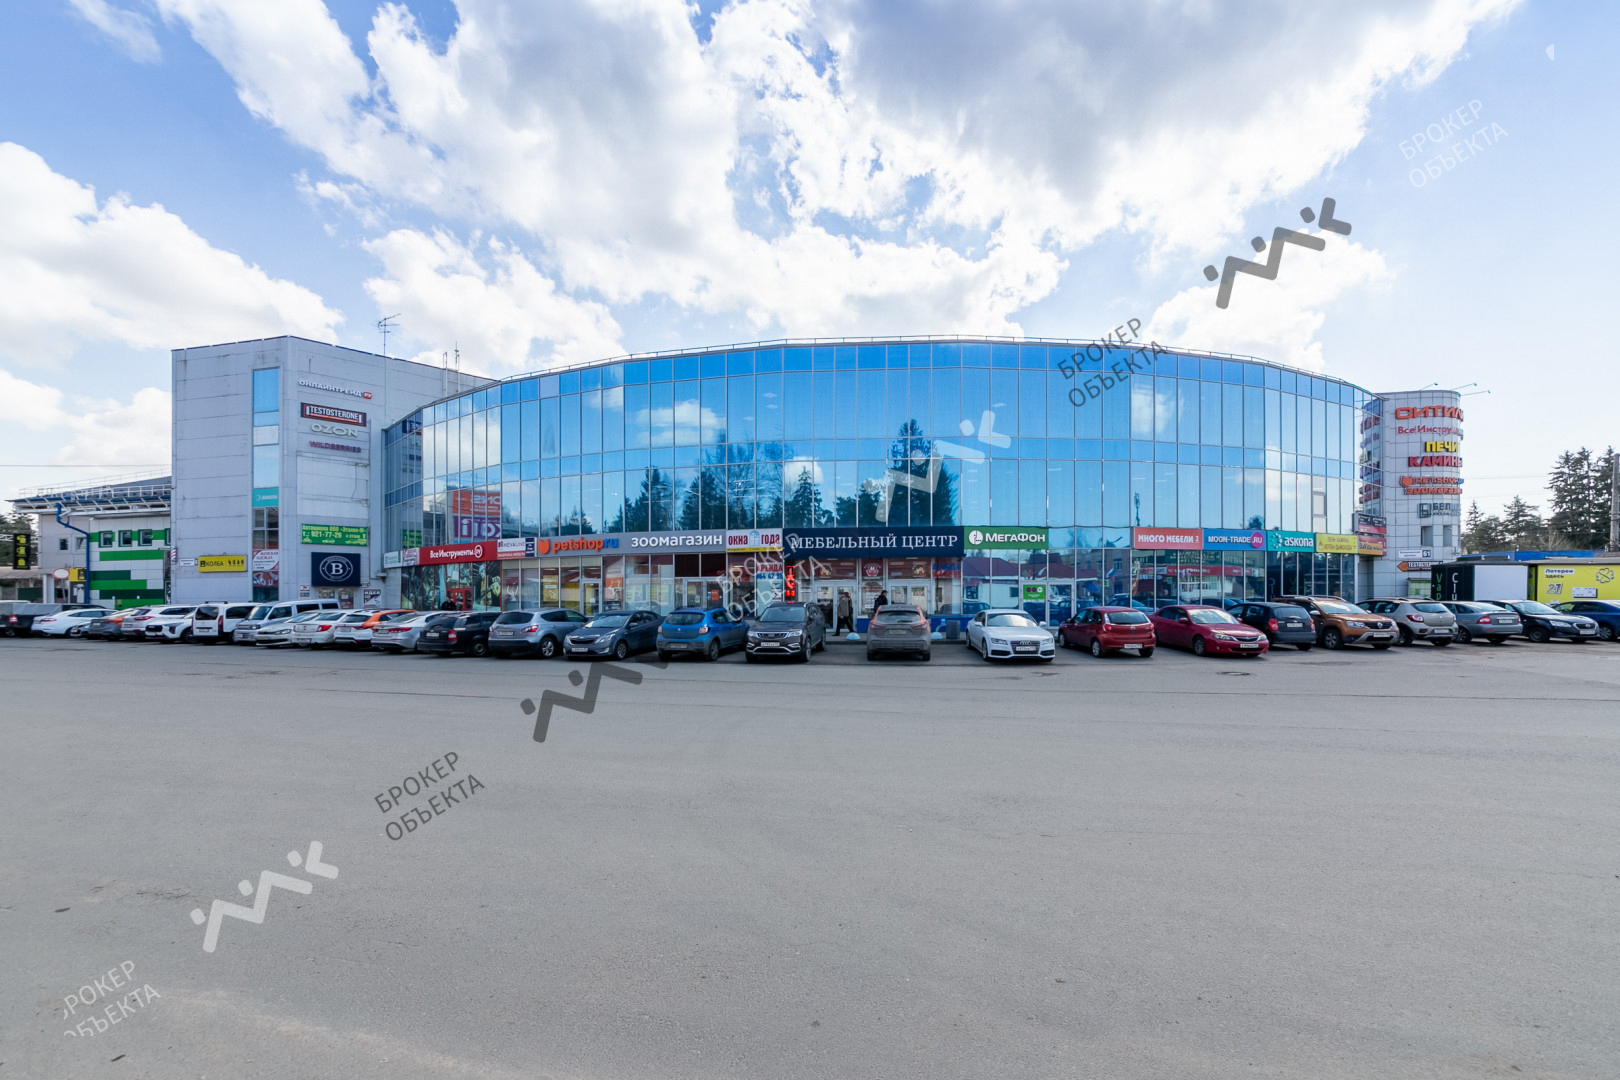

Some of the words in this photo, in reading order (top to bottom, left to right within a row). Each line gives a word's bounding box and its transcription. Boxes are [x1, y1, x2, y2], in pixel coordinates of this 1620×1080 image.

[309, 405, 359, 420] TESTOSTERONE
[311, 423, 358, 437] OZON
[1425, 441, 1458, 452] ПЕЧИ
[631, 535, 723, 547] зоомагазин
[790, 533, 898, 549] МЕБЕЛЬНЫЙ
[901, 535, 958, 550] ЦЕНТР
[1138, 535, 1164, 543] МНОГО
[1166, 535, 1193, 543] МЕБЕЛИ
[1284, 537, 1314, 547] askona
[330, 563, 343, 575] B
